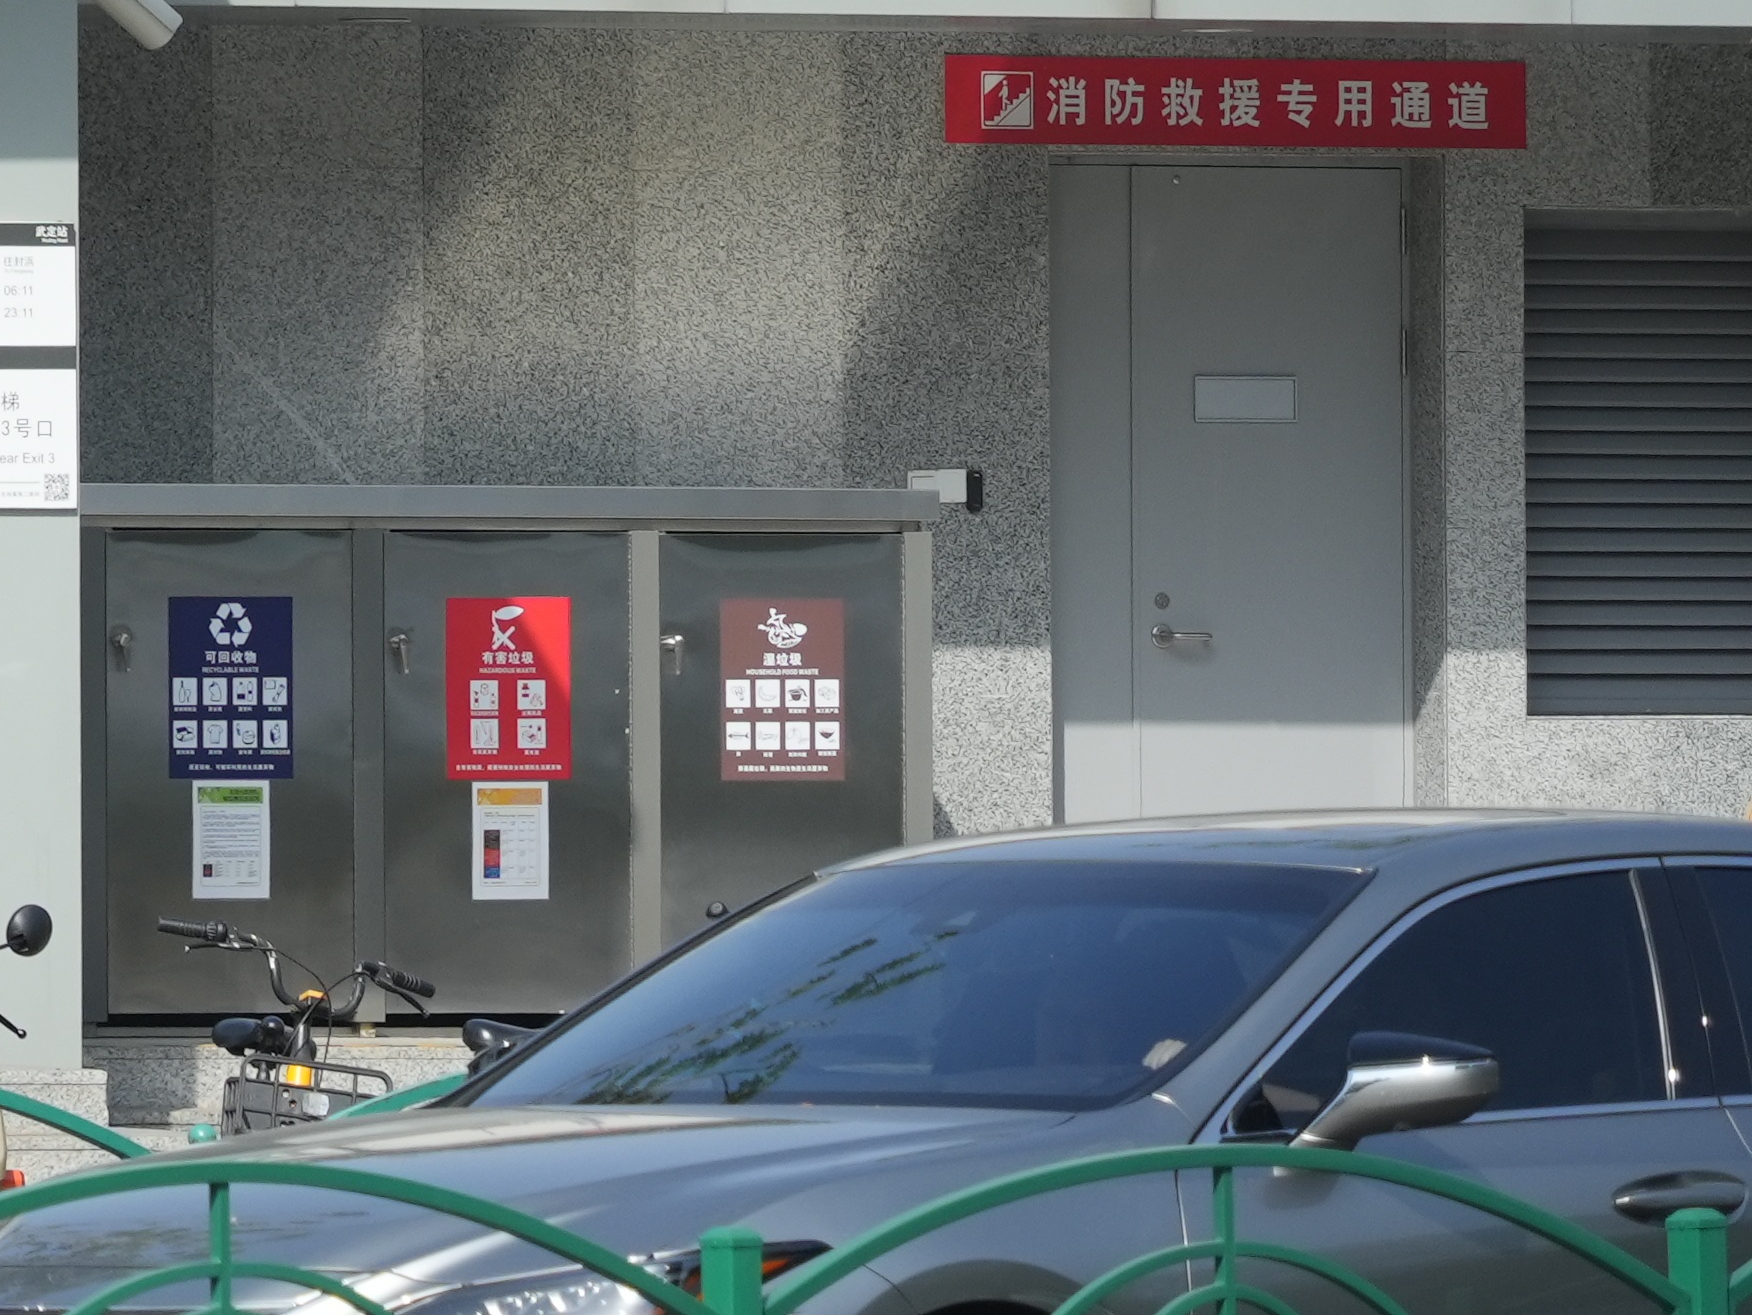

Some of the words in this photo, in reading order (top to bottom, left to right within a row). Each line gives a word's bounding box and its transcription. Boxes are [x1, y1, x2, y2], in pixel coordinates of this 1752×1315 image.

[1046, 76, 1490, 131] 消防救援专用通道
[4, 284, 34, 296] 06:11
[4, 307, 34, 318] 23:11
[22, 452, 44, 464] Exit
[48, 452, 56, 464] 3
[204, 650, 257, 664] 可回收物
[481, 651, 534, 665] 有害垃圾
